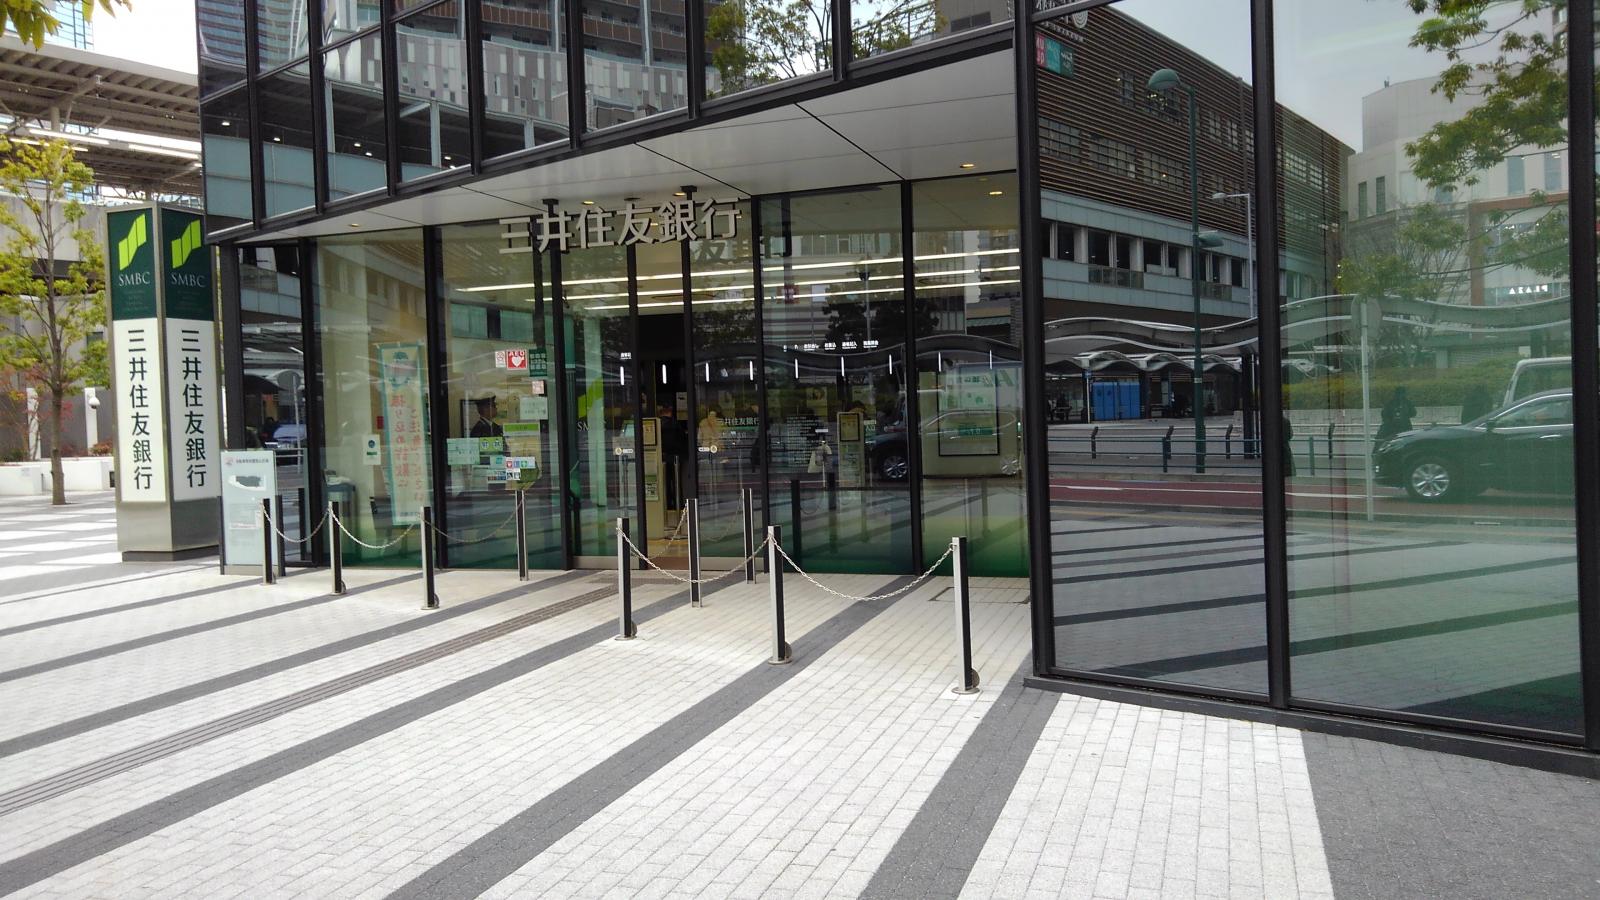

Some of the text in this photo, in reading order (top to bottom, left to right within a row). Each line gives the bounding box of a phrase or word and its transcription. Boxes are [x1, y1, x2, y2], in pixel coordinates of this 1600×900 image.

[499, 197, 742, 253] 三井住友銀行
[118, 272, 151, 286] SMBC
[171, 273, 206, 288] SMBC
[508, 350, 526, 358] AED
[127, 329, 153, 490] 三井住友銀行
[181, 328, 207, 489] 三井住友銀行
